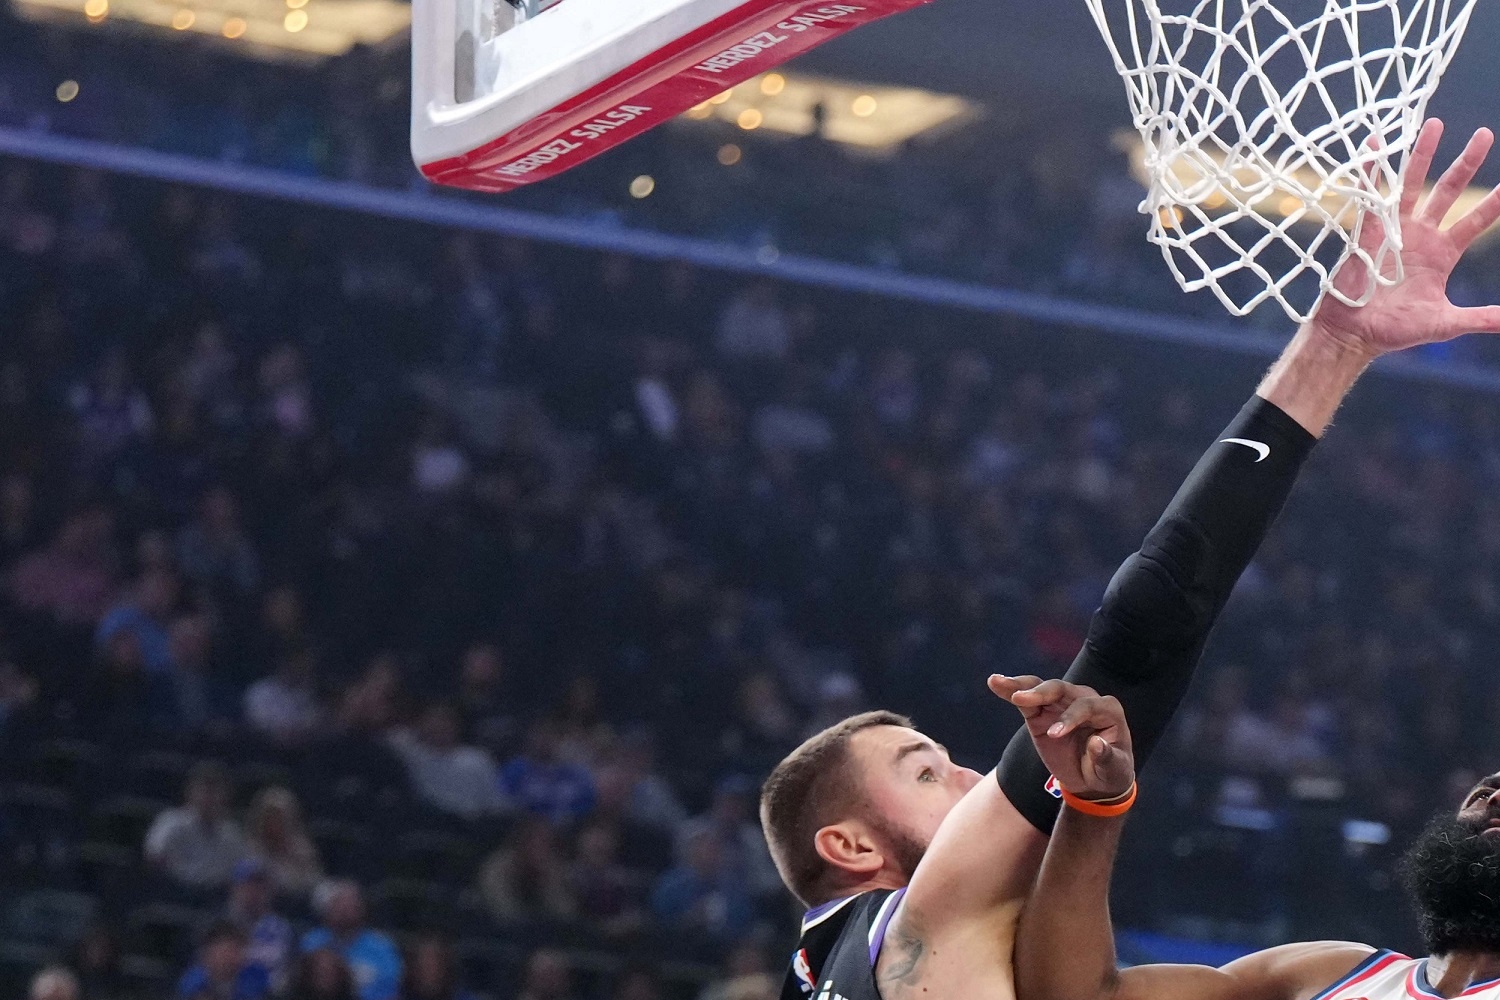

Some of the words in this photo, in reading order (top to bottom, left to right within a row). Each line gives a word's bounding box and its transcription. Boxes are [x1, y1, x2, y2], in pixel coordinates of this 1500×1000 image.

[694, 31, 790, 73] HERDEZ
[776, 4, 867, 32] SALSA
[495, 138, 583, 176] HERDEZ
[570, 103, 653, 140] SALSA
